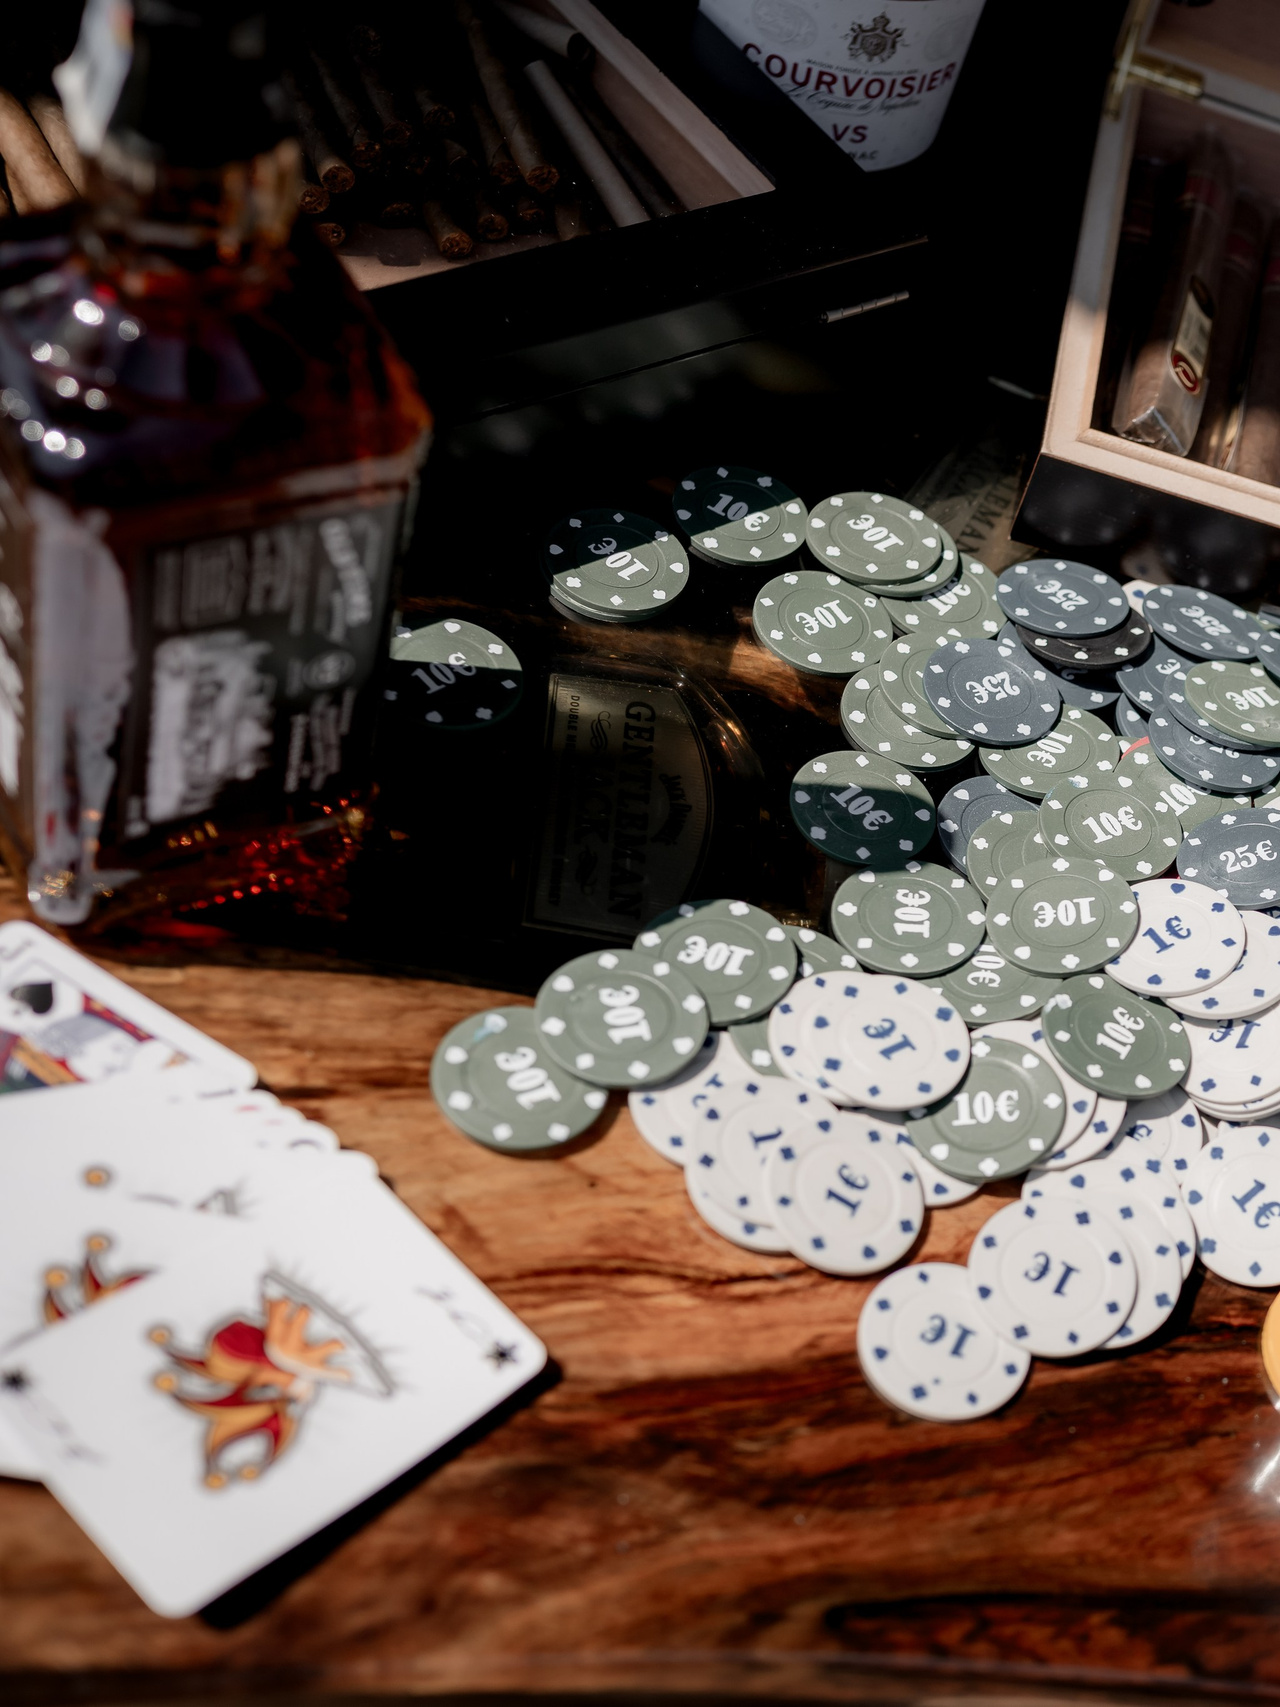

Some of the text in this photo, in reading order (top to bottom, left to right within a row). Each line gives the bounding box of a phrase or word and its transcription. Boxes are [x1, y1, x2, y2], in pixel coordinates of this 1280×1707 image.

[741, 43, 957, 100] COURVOISIER
[832, 123, 868, 144] VS
[706, 492, 771, 533] 10€
[846, 514, 904, 553] 10€
[587, 537, 650, 582] 10€
[1035, 578, 1090, 612] 25€
[795, 600, 853, 636] 10€
[1178, 605, 1233, 638] 25€
[410, 652, 479, 696] 10€
[965, 671, 1021, 705] 25€
[1225, 686, 1280, 712] 10€
[1026, 730, 1074, 769] 10€
[607, 701, 656, 921] GENTLEMAN
[829, 782, 895, 832] 10€
[1082, 804, 1144, 845] 10€
[1219, 839, 1278, 874] 25€
[893, 889, 931, 939] 10€
[1033, 896, 1097, 928] 10€
[1142, 915, 1192, 955] 1€
[677, 935, 756, 977] 10€
[599, 984, 653, 1045] 10€
[1096, 1006, 1146, 1060] 10€
[1208, 1019, 1262, 1049] 1€
[862, 1018, 918, 1061] 1€
[494, 1046, 562, 1111] 10€
[951, 1088, 1021, 1127] 10€
[826, 1163, 870, 1218] 1€
[1023, 1250, 1082, 1299] 1€
[919, 1313, 980, 1361] 1€
